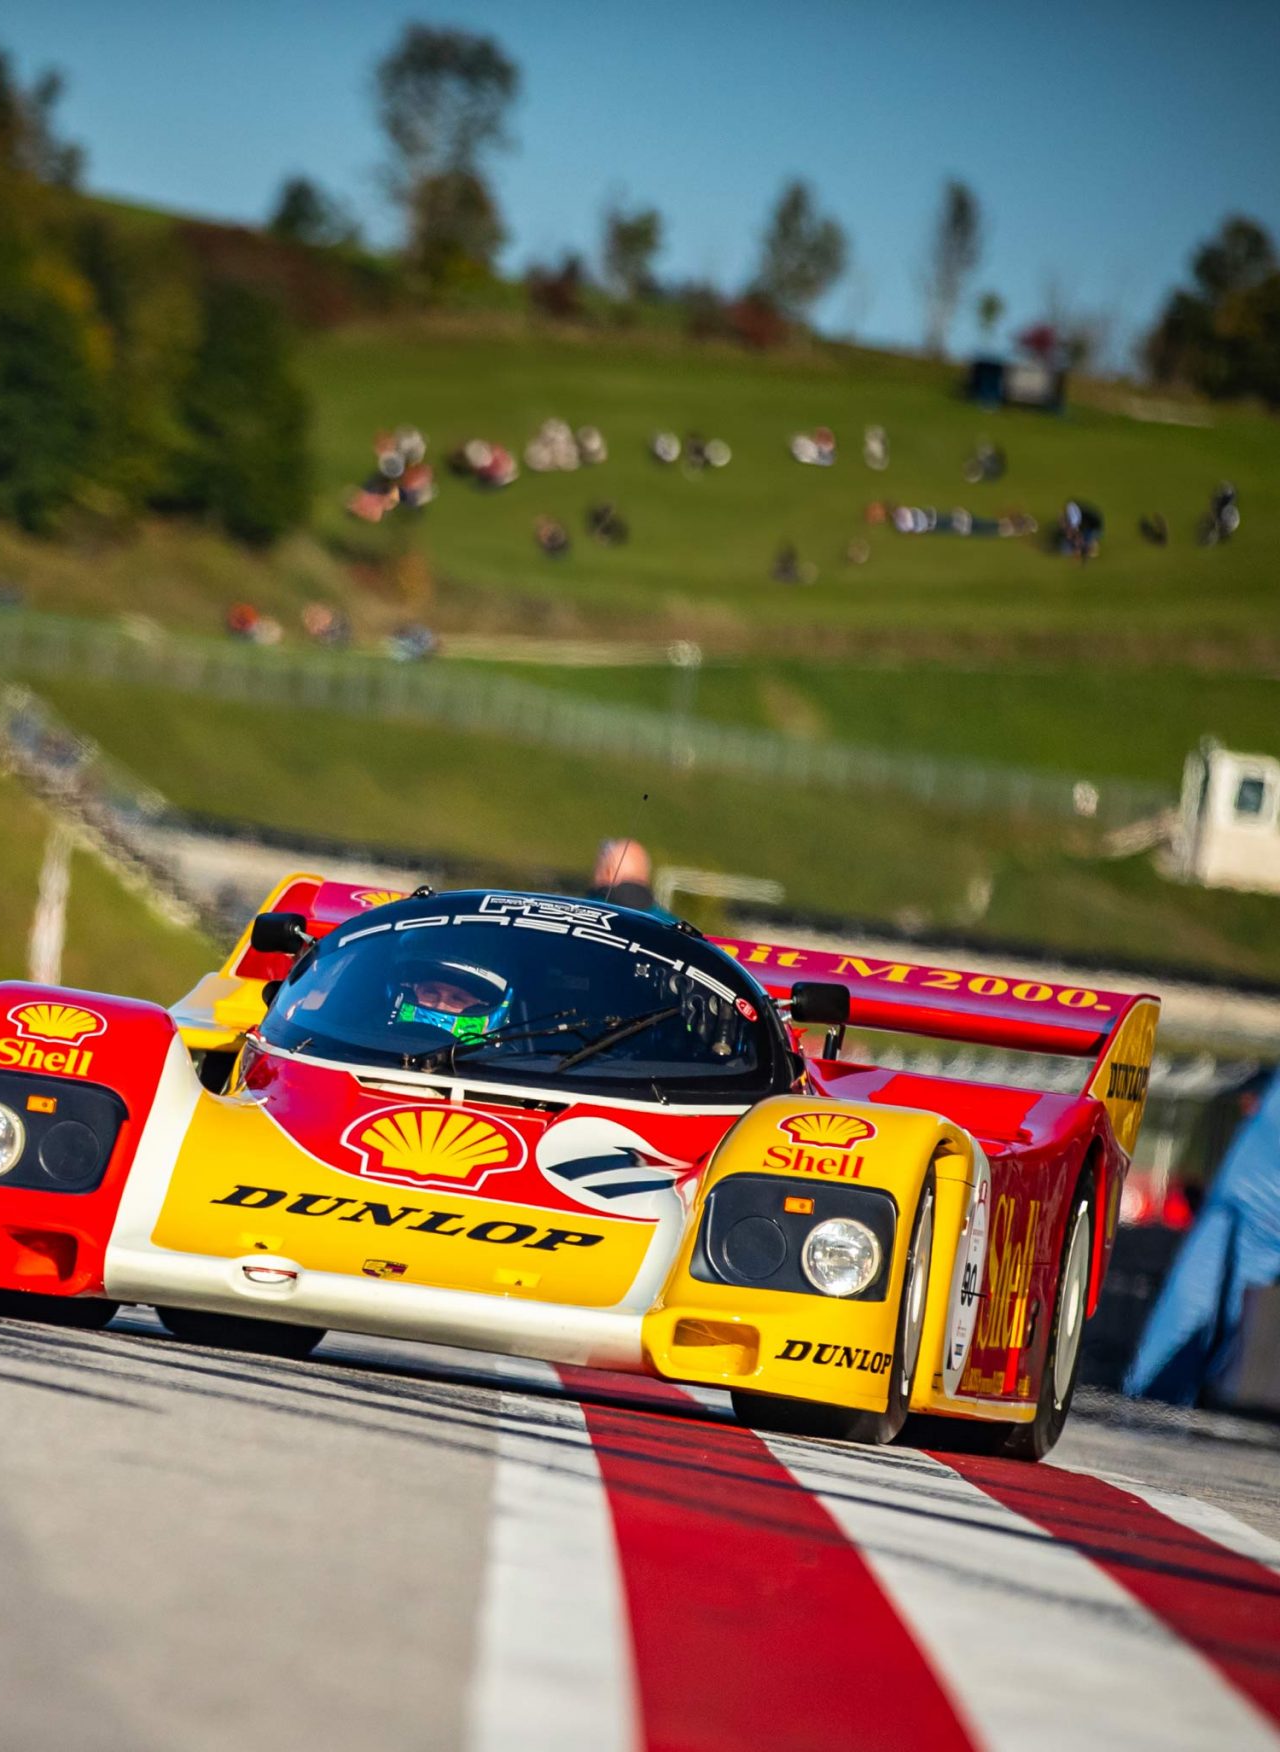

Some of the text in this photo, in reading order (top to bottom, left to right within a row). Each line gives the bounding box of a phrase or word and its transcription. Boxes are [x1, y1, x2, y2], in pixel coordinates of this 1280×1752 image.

[339, 914, 737, 1004] PORSCHE
[1107, 1062, 1150, 1101] DUNLOP
[763, 1145, 864, 1179] Shell
[211, 1184, 605, 1251] DUNLOP
[976, 1192, 1041, 1350] Shell
[775, 1339, 892, 1376] DUNLOP
